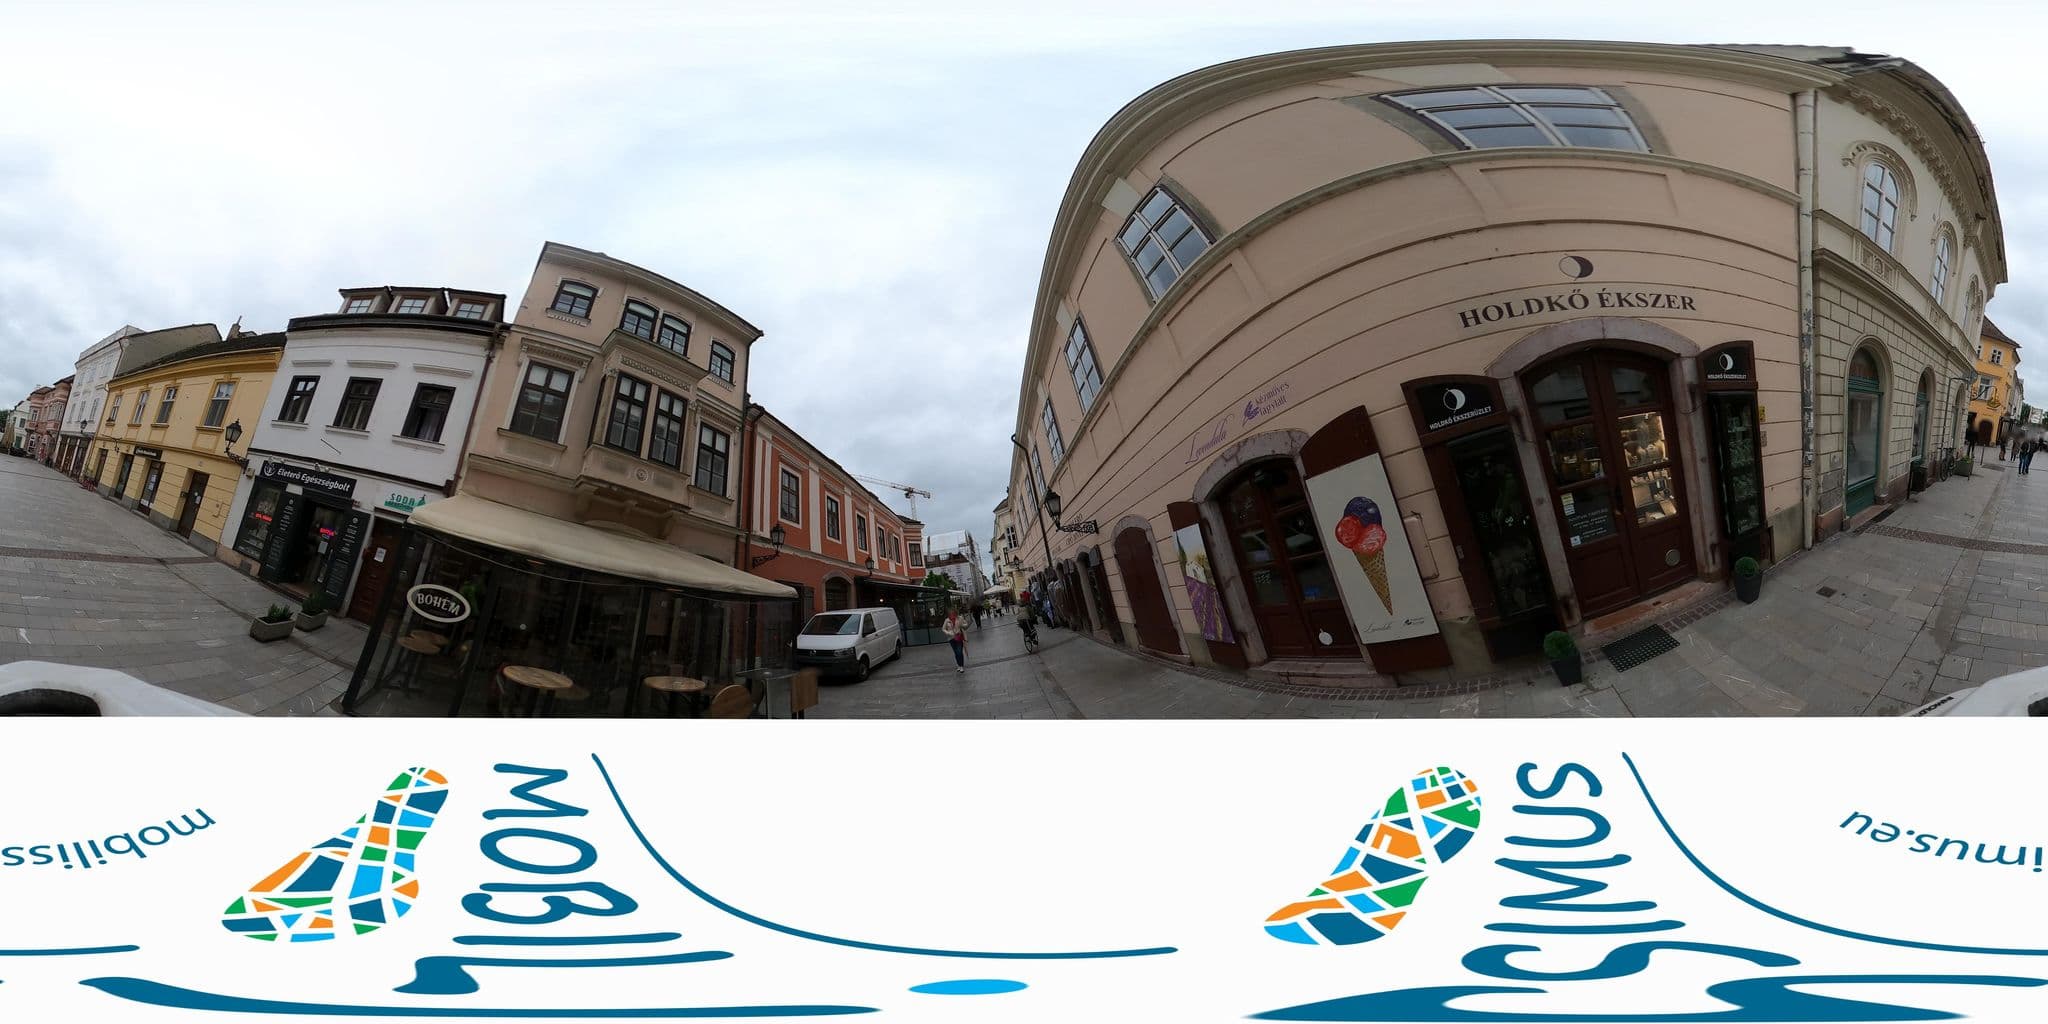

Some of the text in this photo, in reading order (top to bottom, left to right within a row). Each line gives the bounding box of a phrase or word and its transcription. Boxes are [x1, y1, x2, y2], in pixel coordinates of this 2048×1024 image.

[1457, 288, 1697, 328] HOLDKŐ ÉKSZER
[301, 473, 351, 492] Egészségbolt
[416, 592, 462, 616] BOHÉM
